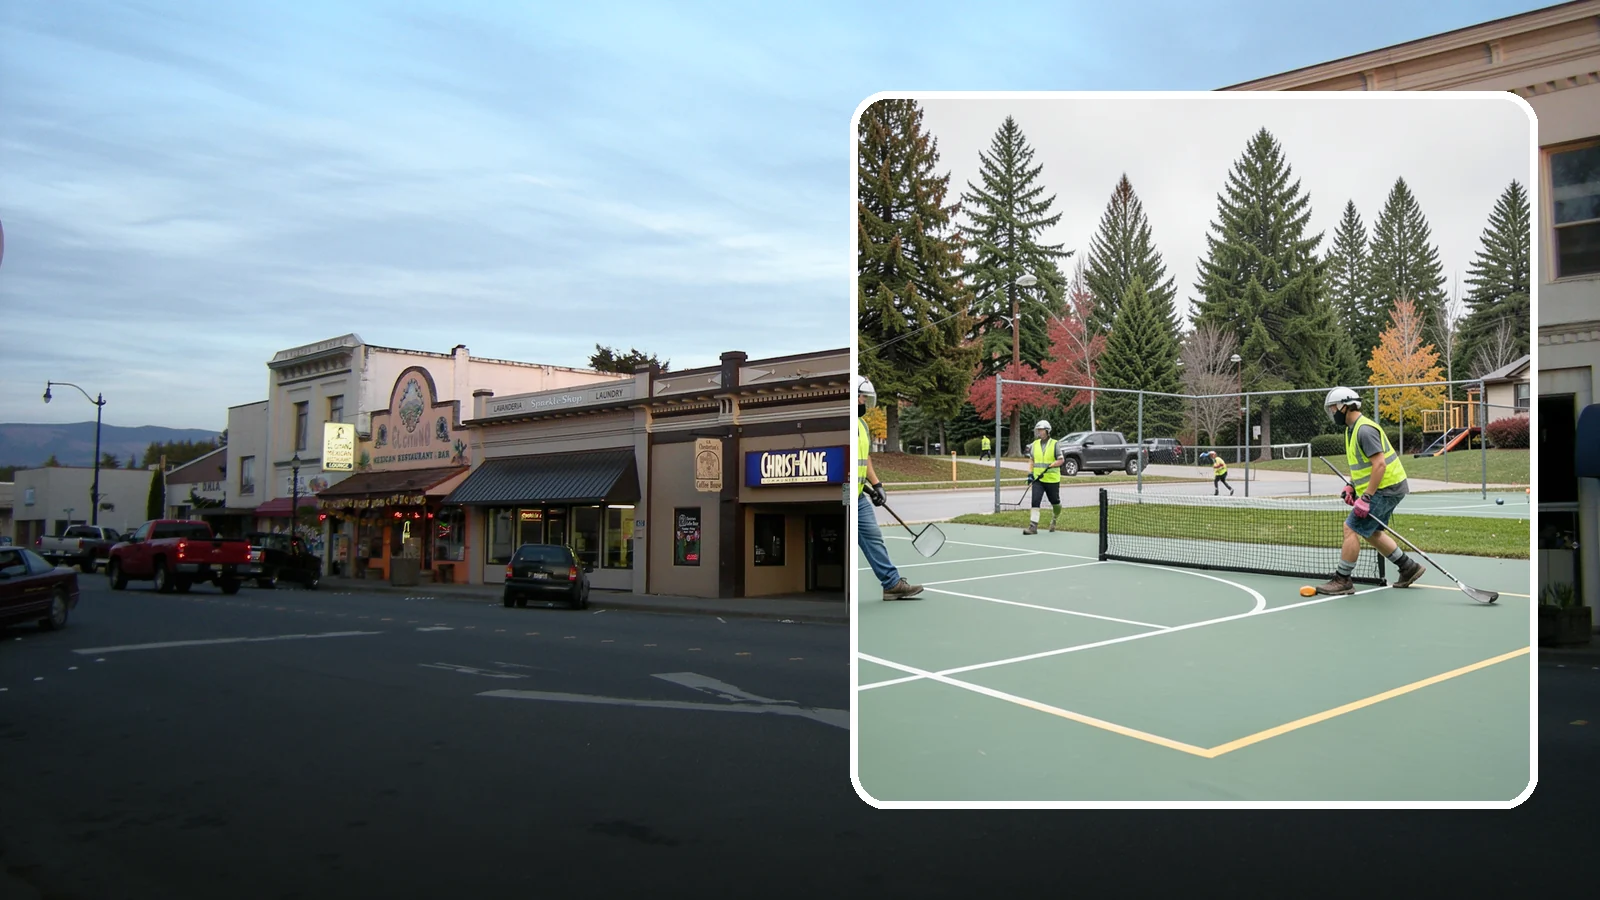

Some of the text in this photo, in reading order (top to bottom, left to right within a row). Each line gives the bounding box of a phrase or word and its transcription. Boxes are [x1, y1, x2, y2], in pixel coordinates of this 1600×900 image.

[562, 394, 582, 406] Shop
[595, 388, 623, 400] LAUNDRY
[494, 402, 523, 413] LAVANDERIA
[374, 455, 396, 464] MEXICAN
[397, 451, 433, 463] RESTAURANT
[438, 450, 450, 459] BAR
[761, 450, 827, 477] CHRIST KING
